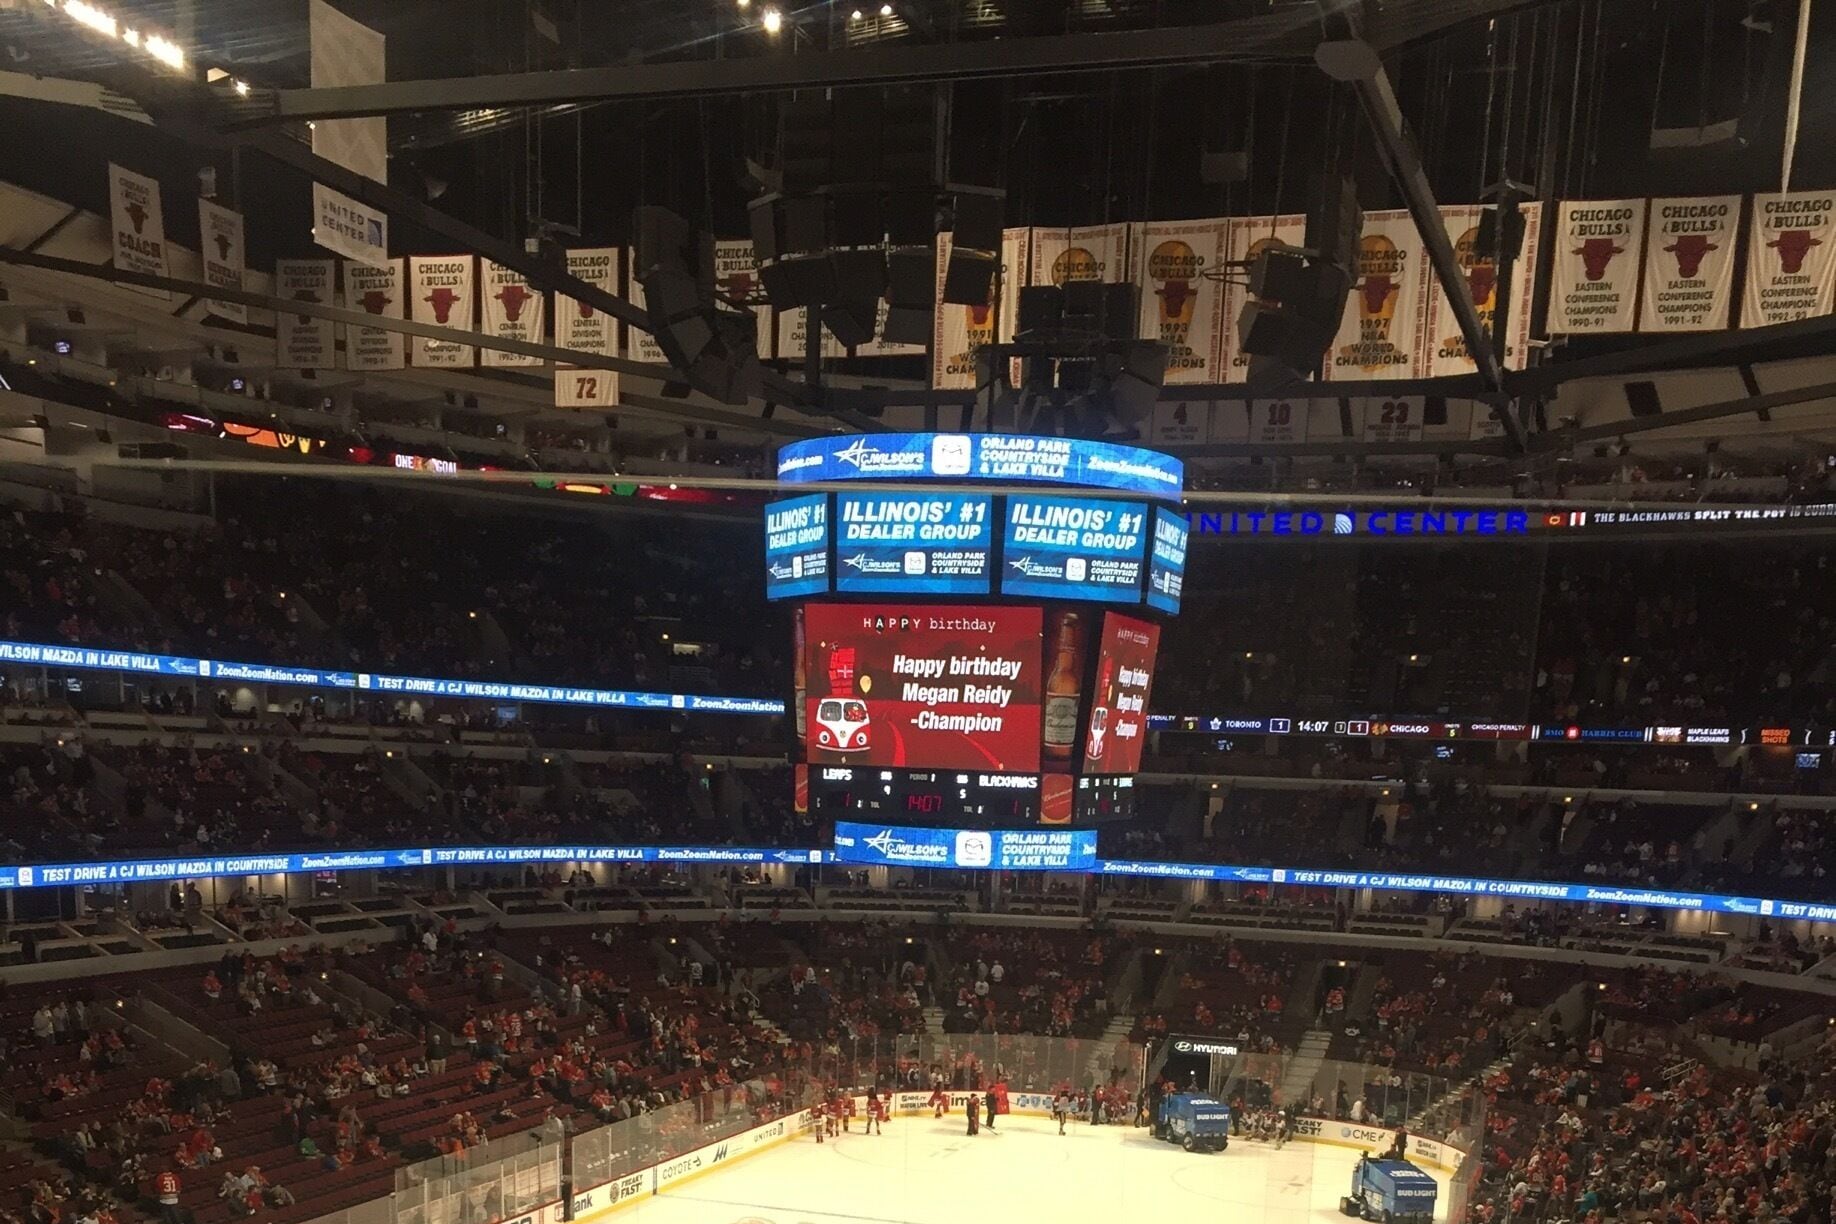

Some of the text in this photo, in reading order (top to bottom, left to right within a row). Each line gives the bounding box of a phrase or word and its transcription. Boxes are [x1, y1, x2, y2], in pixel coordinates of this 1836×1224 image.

[321, 200, 365, 226] UNITED
[1661, 204, 1729, 219] CHICAGO
[1764, 199, 1833, 214] CHICAGO
[1569, 207, 1633, 222] CHICAGO
[322, 215, 366, 242] CENTER
[1670, 220, 1718, 233] BULLS
[1773, 215, 1822, 229] BULLS
[1578, 223, 1624, 237] BULLS
[1055, 261, 1106, 273] CHICAGO
[1152, 255, 1205, 266] CHICAGO
[418, 263, 465, 274] CHICAGO
[426, 275, 459, 286] BULLS
[1575, 281, 1613, 292] EASTERN
[1667, 279, 1706, 290] EASTERN
[1771, 275, 1811, 286] EASTERN
[1564, 293, 1620, 304] CONFERENCE
[1657, 290, 1714, 301] CONFERENCE
[1760, 286, 1818, 298] CONFERENCE
[1564, 305, 1617, 316] CHAMPIONS
[1657, 303, 1712, 313] CHAMPIONS
[1760, 299, 1817, 311] CHAMPIONS
[1359, 318, 1390, 330] 1997
[1567, 317, 1605, 327] 1990-91
[1663, 315, 1703, 325] 1991-92
[572, 329, 602, 338] DIVISION
[1159, 322, 1188, 333] 1993
[966, 329, 992, 340] 1991
[1361, 331, 1386, 342] NBA
[566, 340, 606, 349] CHAMPIONS
[1335, 354, 1408, 366] CHAMPIONS
[576, 377, 597, 399] 72
[1173, 403, 1187, 425] 4
[1268, 403, 1291, 425] 10
[1381, 402, 1409, 424] 23
[980, 437, 1072, 453] ORLAND PARK
[395, 455, 414, 469] ONE
[980, 450, 1071, 466] COUNTRYSIDE
[992, 463, 1065, 478] LAKE VILLA
[843, 501, 986, 523] ILLINOIS' #1
[1011, 503, 1142, 534] ILLINOIS' #1
[1594, 509, 1786, 523] THE BLACKHAWKS SPLIT THE POT
[767, 505, 812, 534] ILLINOIS'
[1367, 507, 1528, 535] CENTER
[769, 525, 825, 550] DEALER GROUP
[847, 523, 982, 540] DEALER GROUP
[1014, 526, 1137, 551] DEALER GROUP
[931, 552, 986, 560] ORLAND PARK
[931, 559, 985, 567] COUNTRYSIDE
[1091, 559, 1139, 570] ORLAND PARK
[960, 567, 982, 575] VILLA
[1090, 567, 1138, 577] COUNTRYSIDE
[1116, 576, 1136, 584] VILLA
[863, 617, 996, 634] HAPPY birthday
[892, 655, 1022, 680] Happy birthday
[42, 649, 786, 712] MAZDA IN LAKE VILLA ZoomZoomNation.com TEST DRIVE A CJ WILSON MAZDA IN LAKE VILLA ZoomZoomNation
[902, 682, 1012, 708] Megan Reidy
[910, 710, 1003, 735] -Champion
[1225, 720, 1262, 729] TORONTO
[1298, 720, 1329, 732] 14:07
[1390, 724, 1430, 734] CHICAGO
[822, 768, 853, 781] LEAFS
[978, 775, 1038, 789] BLACKHAWKS
[1001, 833, 1072, 844] ORLAND PARK
[1001, 844, 1072, 855] COUNTRYSIDE
[42, 849, 764, 882] TEST DRIVE A CJ WILSON MAZDA IN COUNTRYSIDE ZoomZoomNation.com TEST DRIVE A CJ WILSON MAZDA LAKE VILLA ZoomZoomNation.com
[1012, 855, 1068, 866] LAKE VILLA
[1103, 862, 1807, 916] ZoomZoomNation.com TEST DRIVE A CJ WILSON MAZDA IN COUNTRYSIDE ZoomZoomNation.com TEST
[1193, 1043, 1238, 1056] HYUNDAI
[1210, 1113, 1229, 1121] LIGHT
[753, 1127, 777, 1143] UNITED
[1352, 1129, 1377, 1143] CME
[662, 1158, 692, 1180] COYOTE
[163, 1180, 177, 1192] 31
[620, 1174, 644, 1189] FREAKY
[1397, 1189, 1436, 1197] BUD LIGHT
